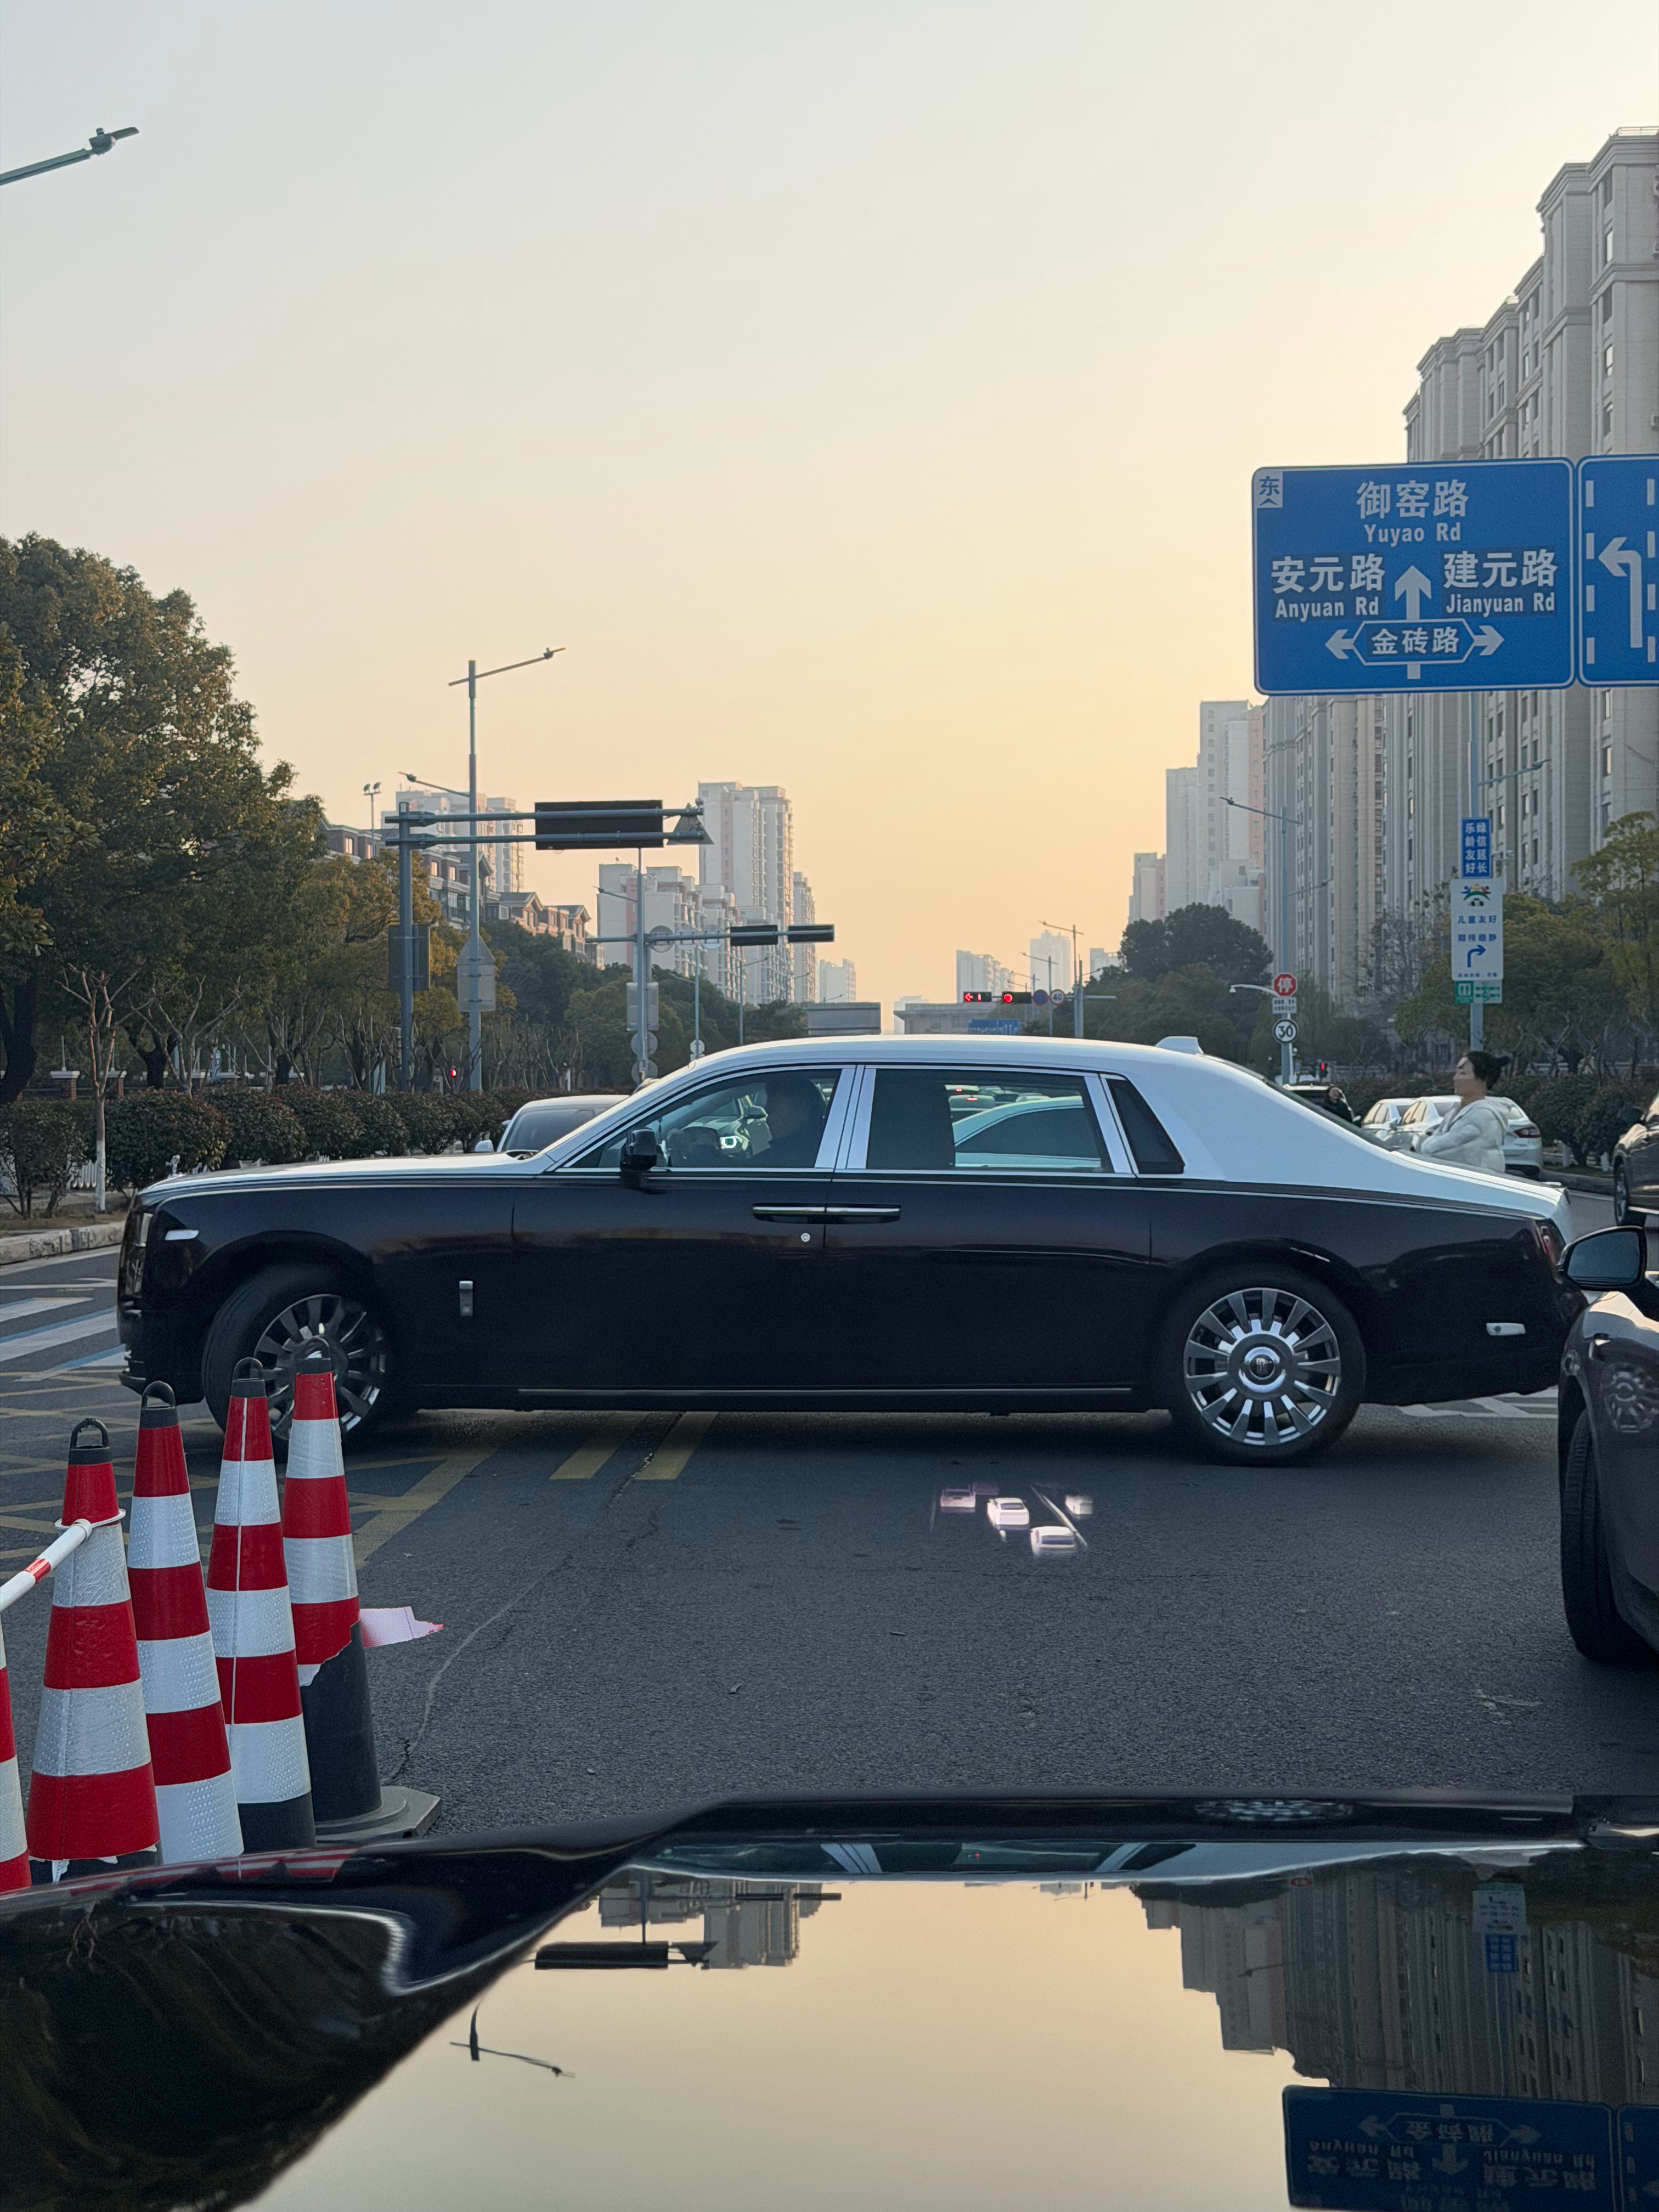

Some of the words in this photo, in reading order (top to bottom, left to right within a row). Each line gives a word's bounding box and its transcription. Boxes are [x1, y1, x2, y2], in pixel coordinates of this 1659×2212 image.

[1259, 476, 1280, 496] 东
[1356, 479, 1469, 519] 御窑路
[1364, 524, 1425, 548] Yuyao
[1436, 522, 1461, 541] Rd
[1271, 554, 1385, 594] 安元路
[1443, 549, 1559, 589] 建元路
[1275, 598, 1345, 622] Anyuan
[1356, 596, 1379, 616] Rd
[1446, 594, 1524, 618] Jianyuan
[1533, 592, 1555, 612] Rd
[1372, 626, 1460, 655] 金砖路
[1278, 1025, 1294, 1039] 30
